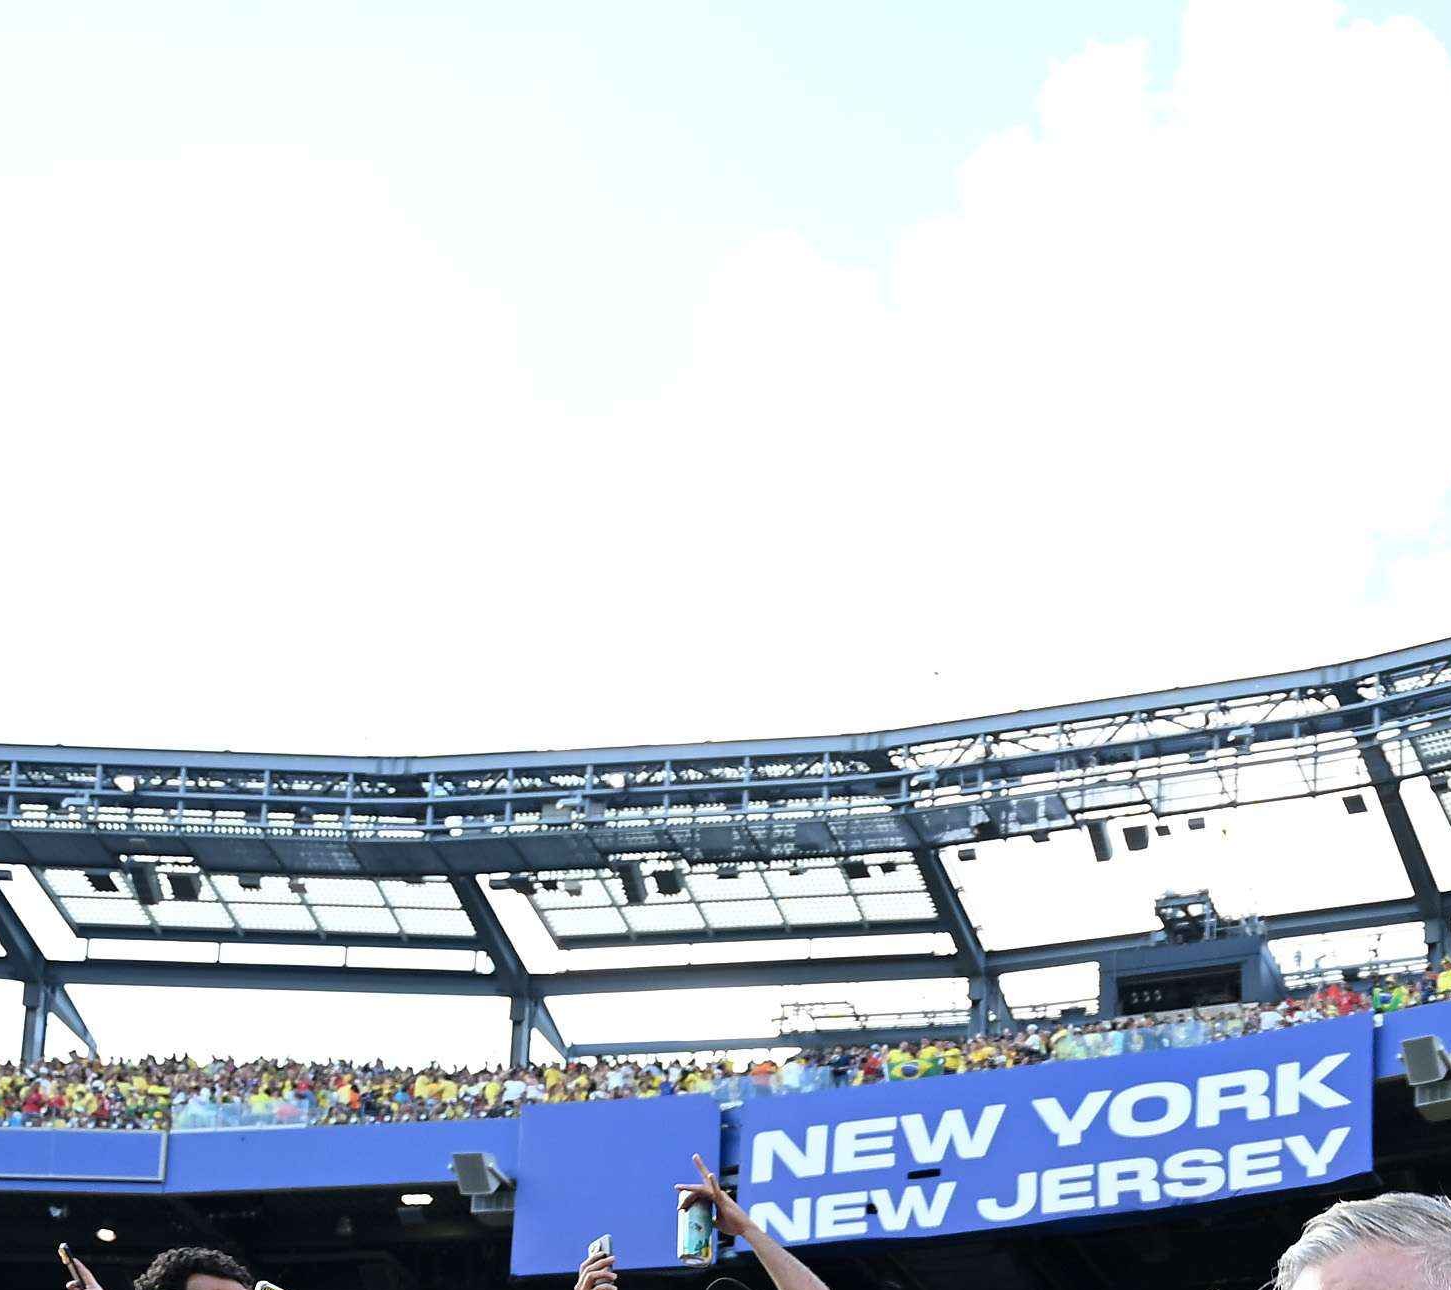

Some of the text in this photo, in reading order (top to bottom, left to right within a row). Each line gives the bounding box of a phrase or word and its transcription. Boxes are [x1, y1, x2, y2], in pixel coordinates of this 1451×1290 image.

[751, 1052, 1352, 1184] NEW YORK
[748, 1126, 1352, 1243] NEW JERSEY
